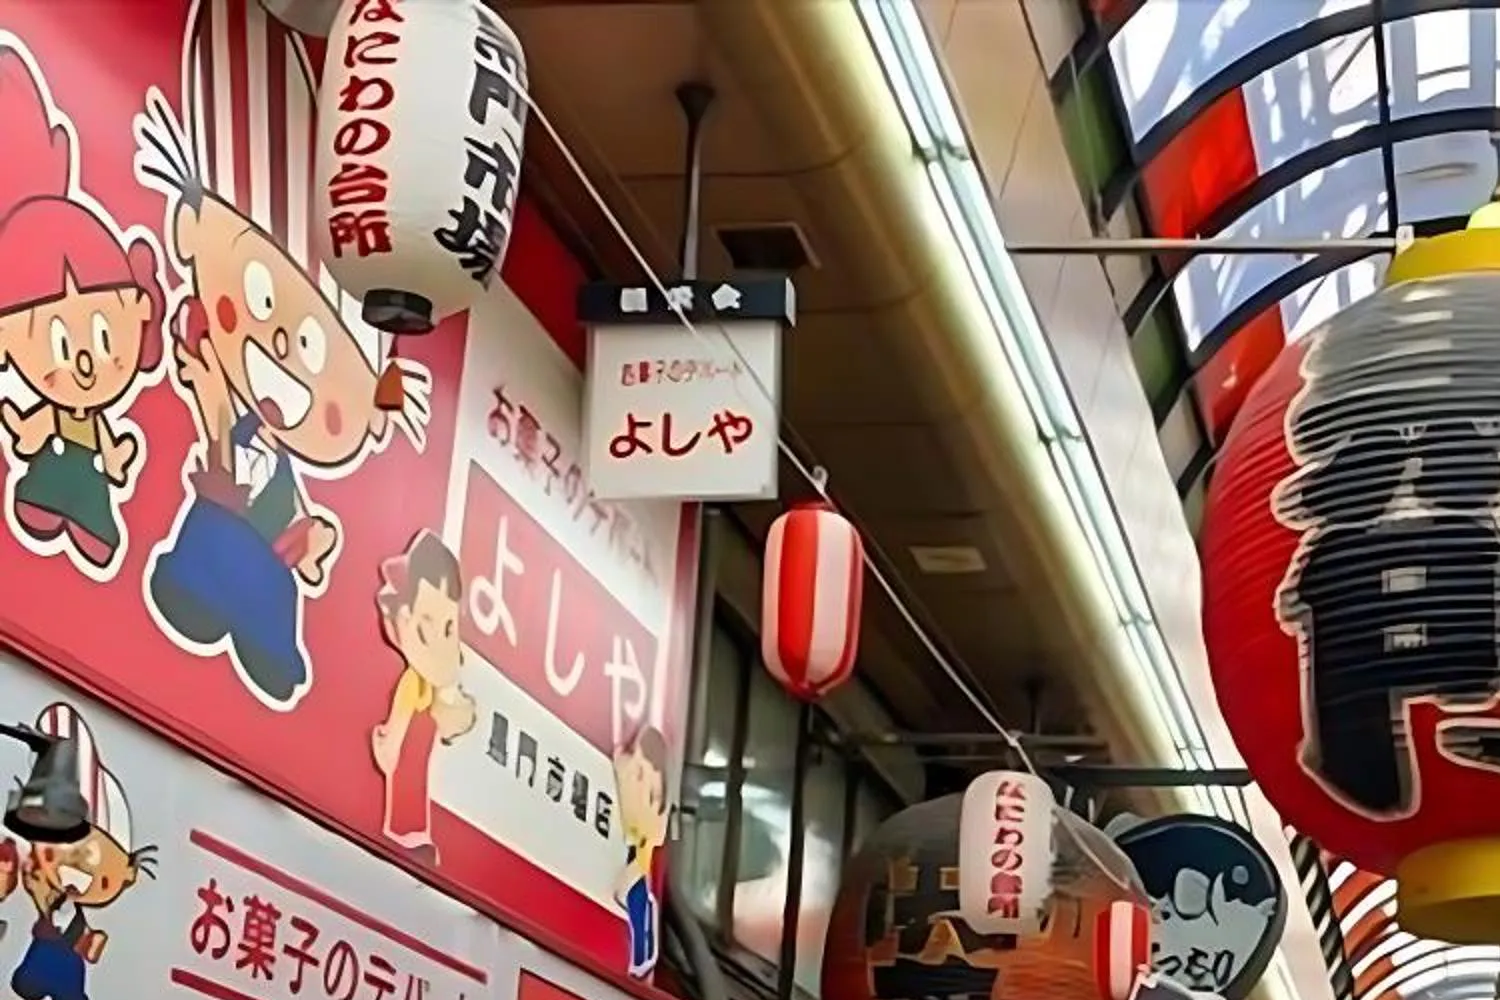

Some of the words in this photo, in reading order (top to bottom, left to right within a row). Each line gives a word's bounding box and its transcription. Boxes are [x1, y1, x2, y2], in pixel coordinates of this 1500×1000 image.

[609, 409, 753, 459] よしや
[468, 514, 648, 745] よしや
